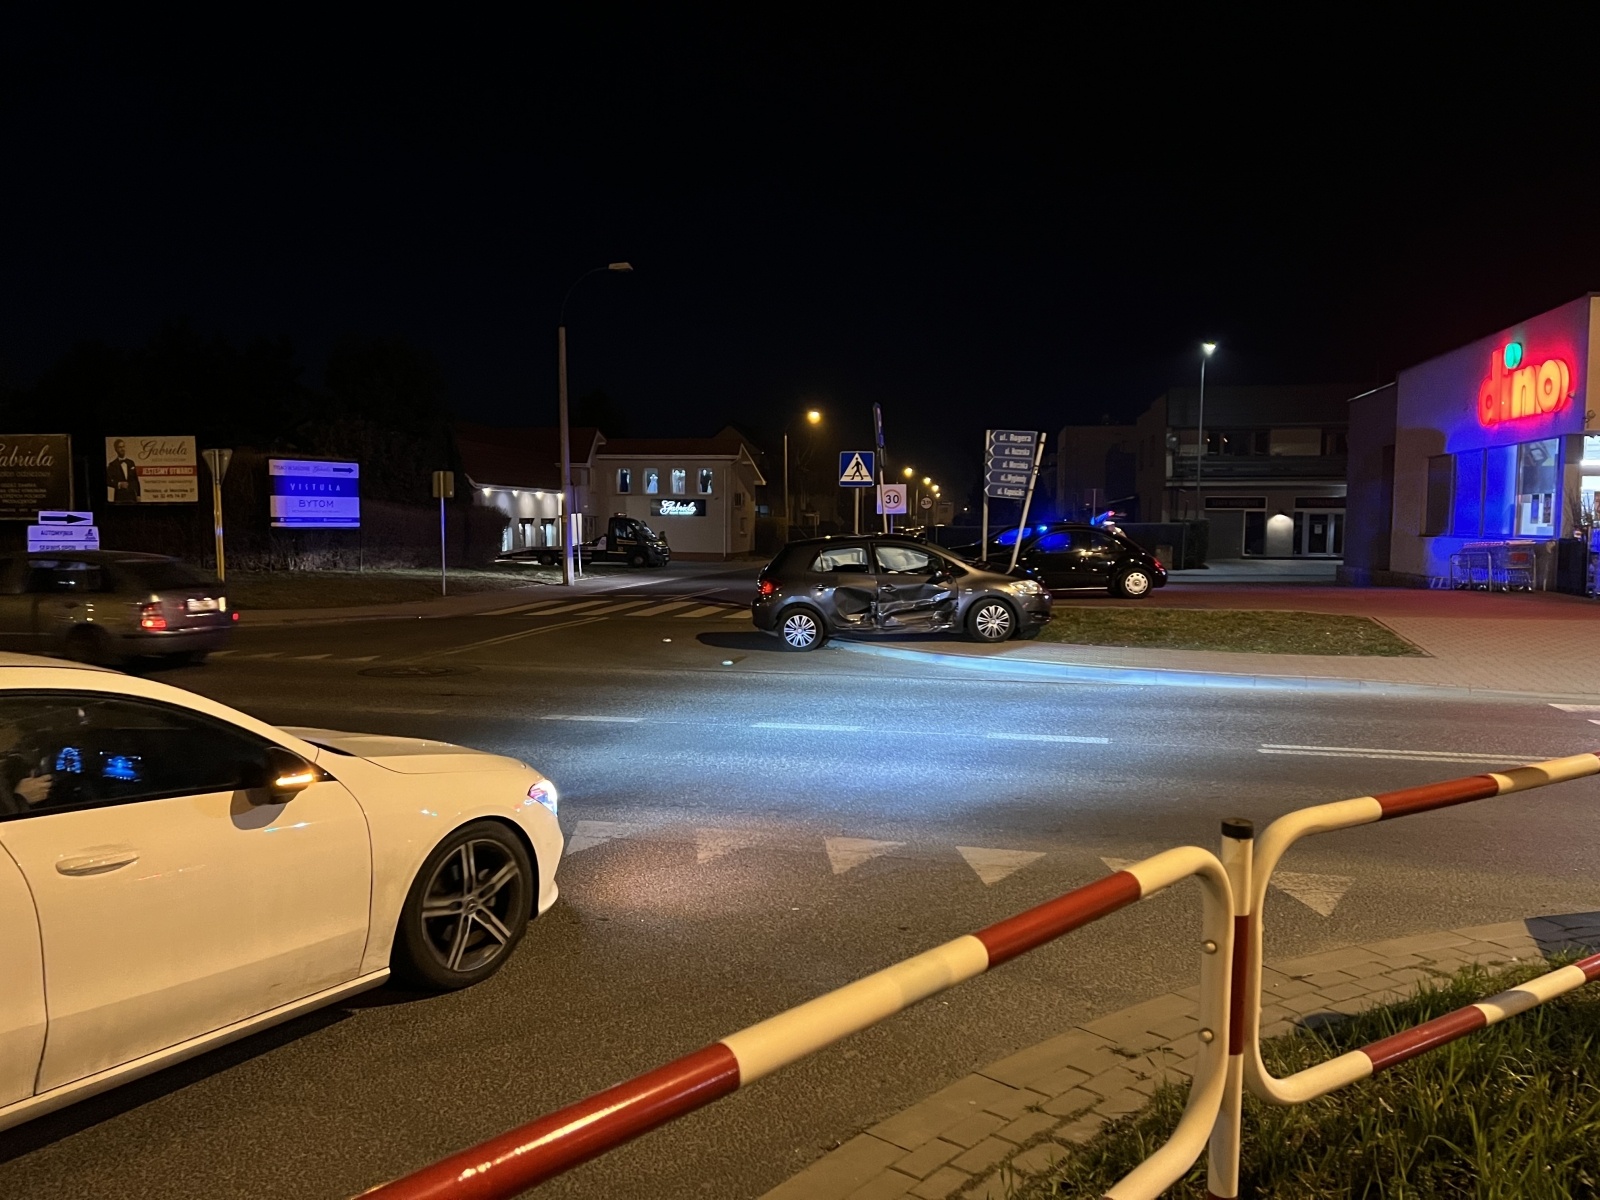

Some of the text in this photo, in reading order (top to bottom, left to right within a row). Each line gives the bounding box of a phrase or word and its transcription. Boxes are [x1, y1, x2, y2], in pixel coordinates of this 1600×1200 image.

[1479, 342, 1570, 427] dino
[138, 440, 188, 460] Gabriela
[290, 483, 341, 491] VISTULA
[298, 499, 334, 508] BYTOM
[885, 494, 899, 504] 30
